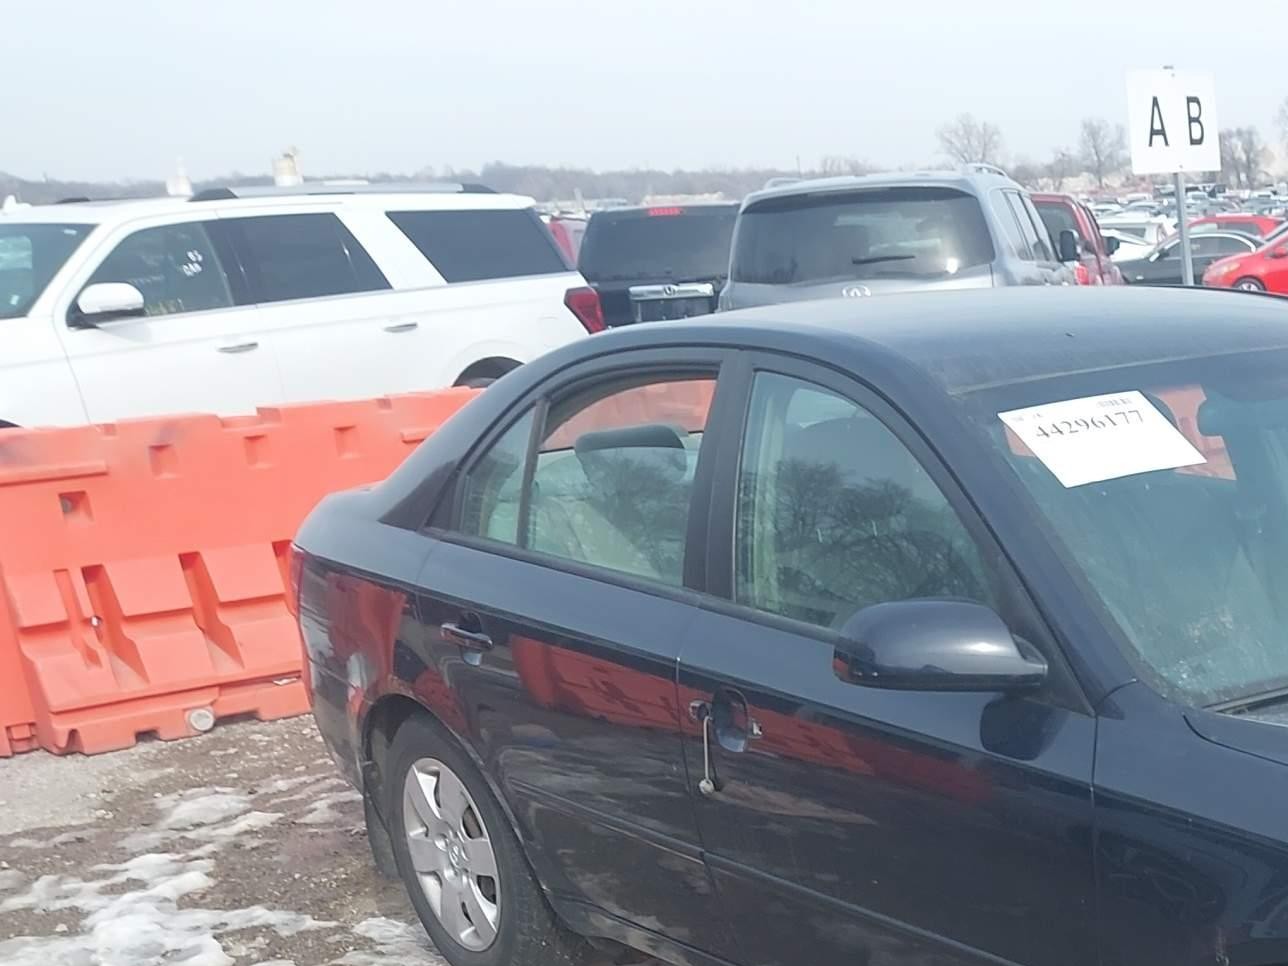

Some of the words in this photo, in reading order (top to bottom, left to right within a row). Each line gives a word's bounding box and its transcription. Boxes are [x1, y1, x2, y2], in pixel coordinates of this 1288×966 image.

[1148, 95, 1169, 147] A
[1186, 95, 1205, 146] B
[1035, 409, 1144, 439] 44296177
